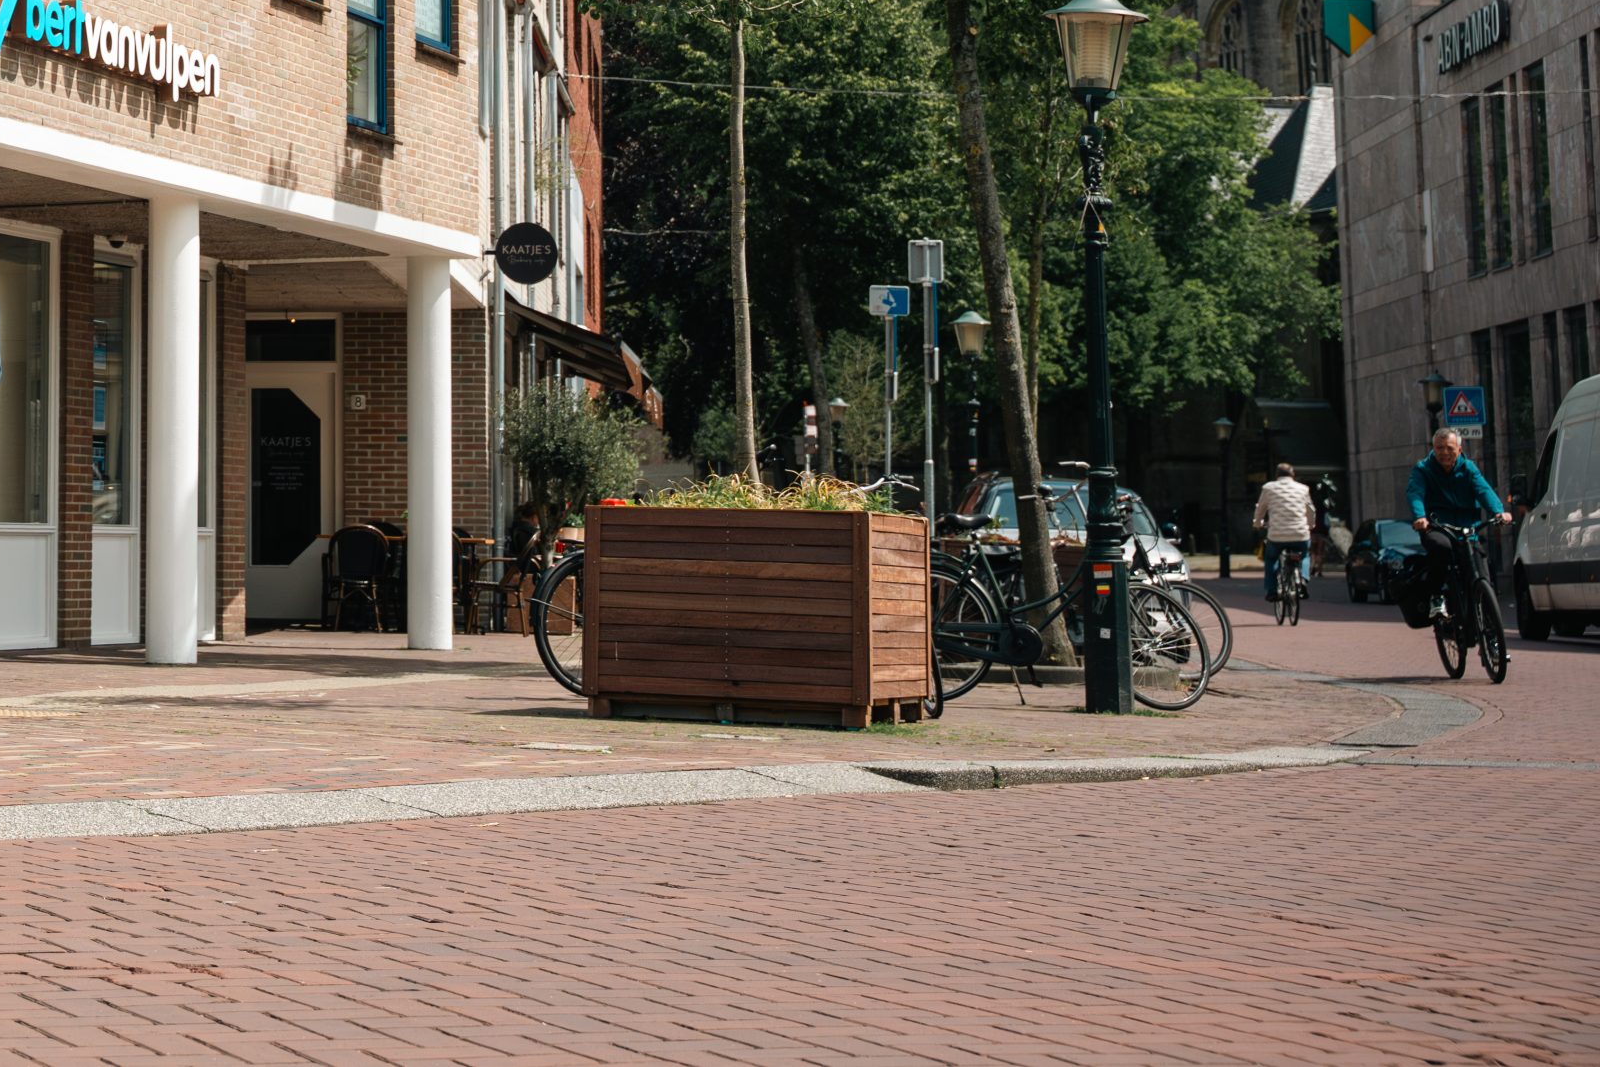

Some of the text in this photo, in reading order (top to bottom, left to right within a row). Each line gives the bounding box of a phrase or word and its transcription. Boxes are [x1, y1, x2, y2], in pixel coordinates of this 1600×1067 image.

[502, 244, 551, 256] KAATJE'S
[355, 396, 362, 408] 8
[260, 436, 312, 448] KAATJE'S
